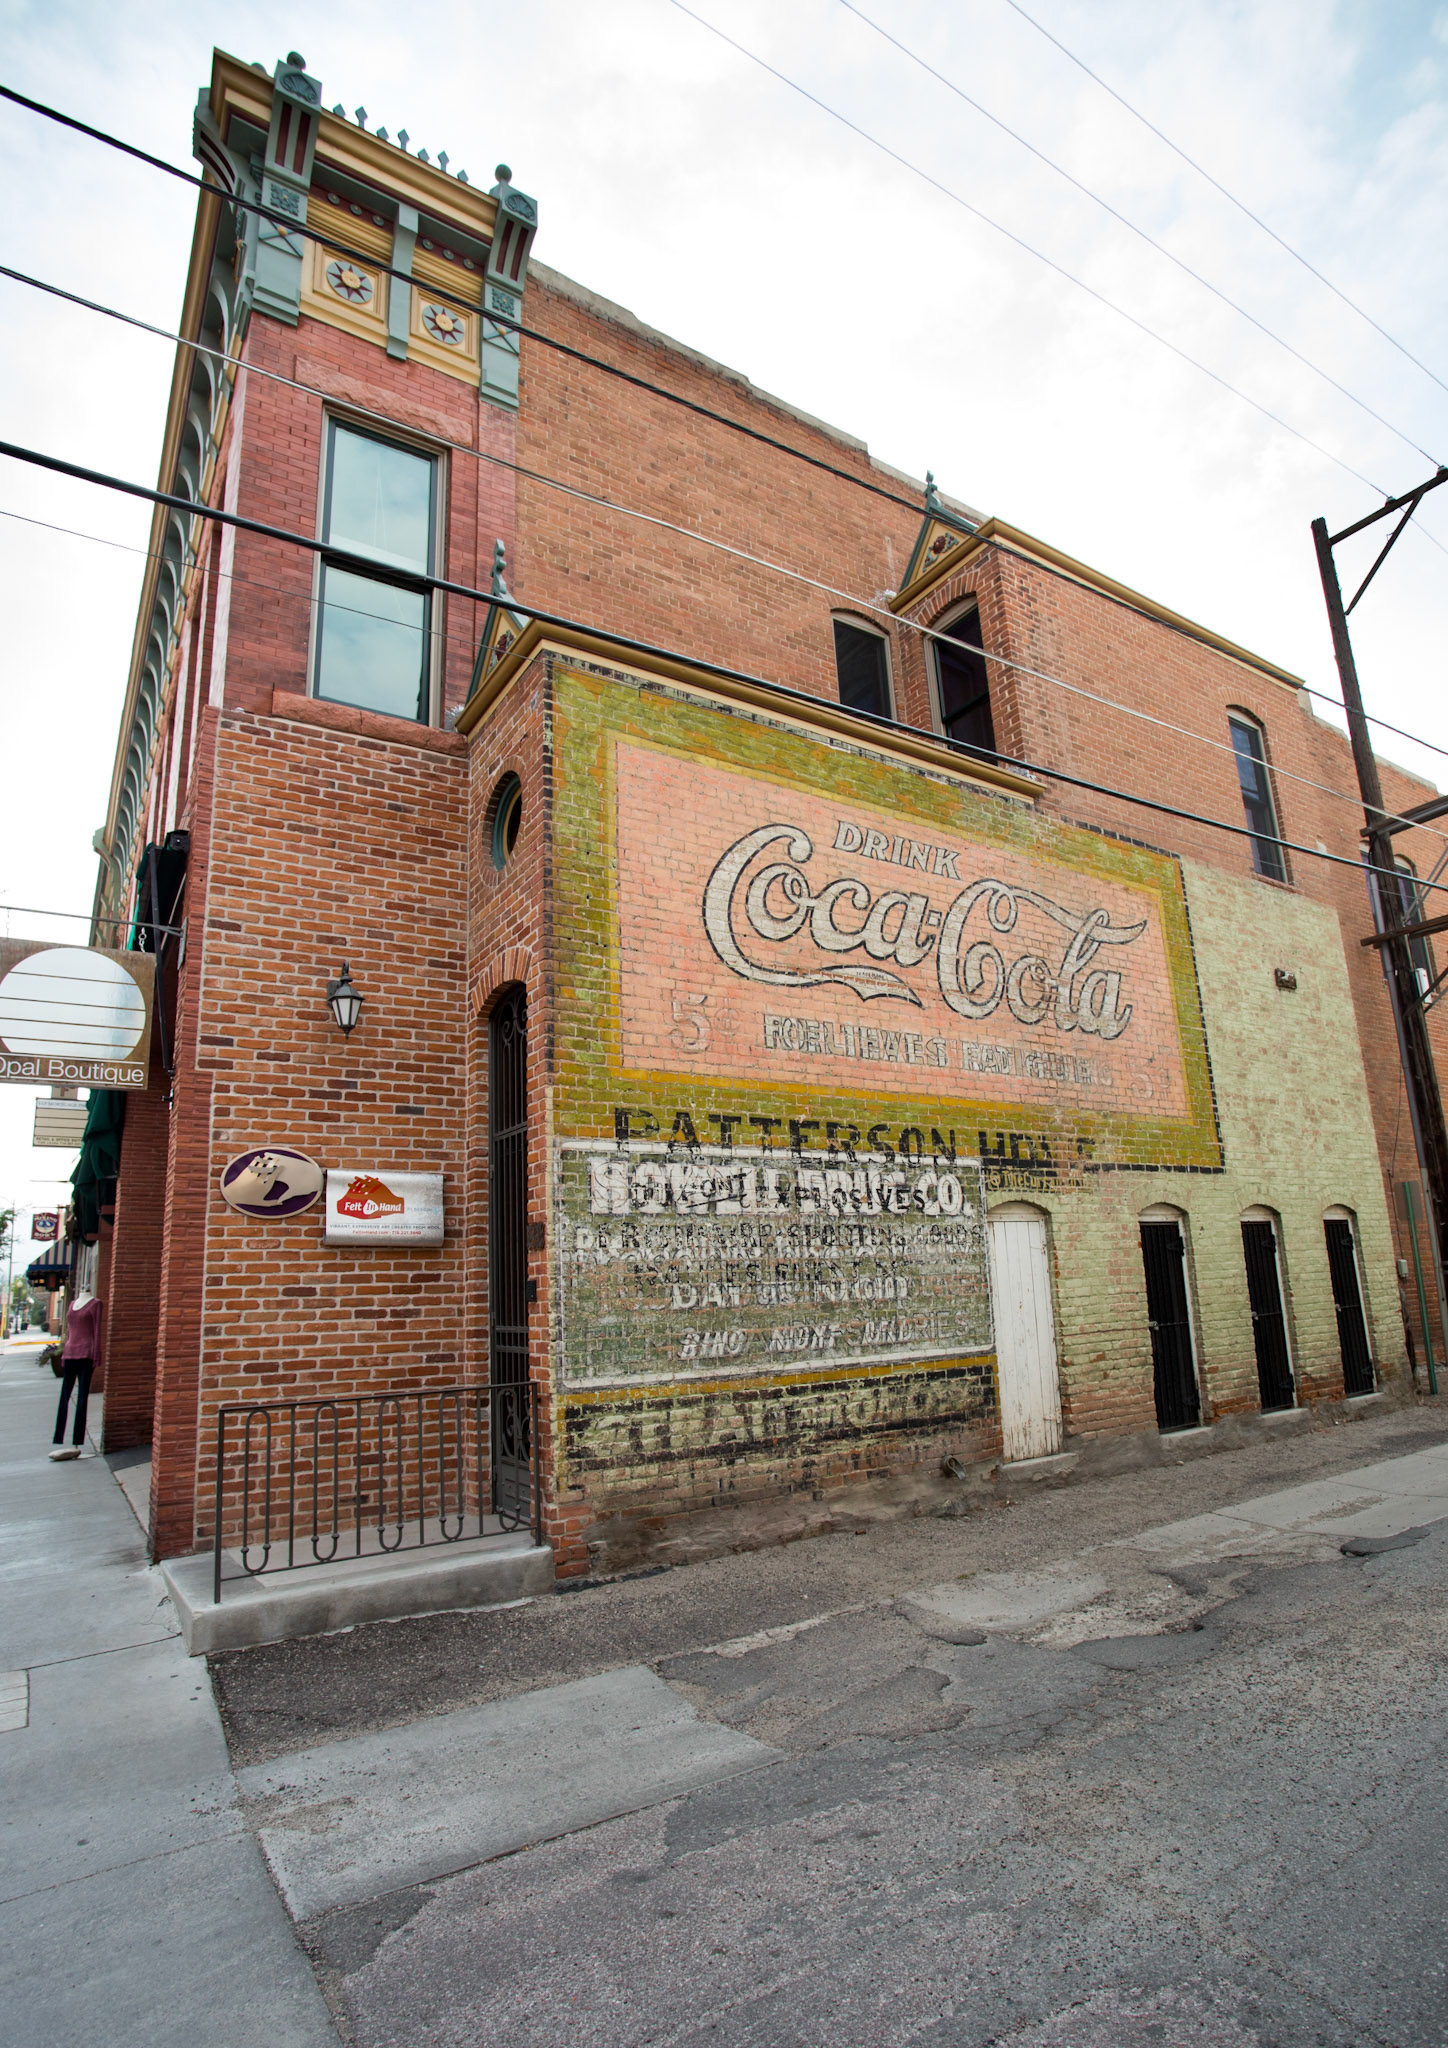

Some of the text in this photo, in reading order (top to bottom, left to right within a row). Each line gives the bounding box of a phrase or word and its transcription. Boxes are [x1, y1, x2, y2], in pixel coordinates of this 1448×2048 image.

[834, 820, 961, 880] DRINK
[703, 823, 1148, 1040] Coca-Cola
[48, 1060, 144, 1085] Boutique
[614, 1108, 957, 1167] PATTERSON
[344, 1201, 362, 1211] Felt
[366, 1202, 376, 1211] In
[379, 1202, 402, 1212] Hand
